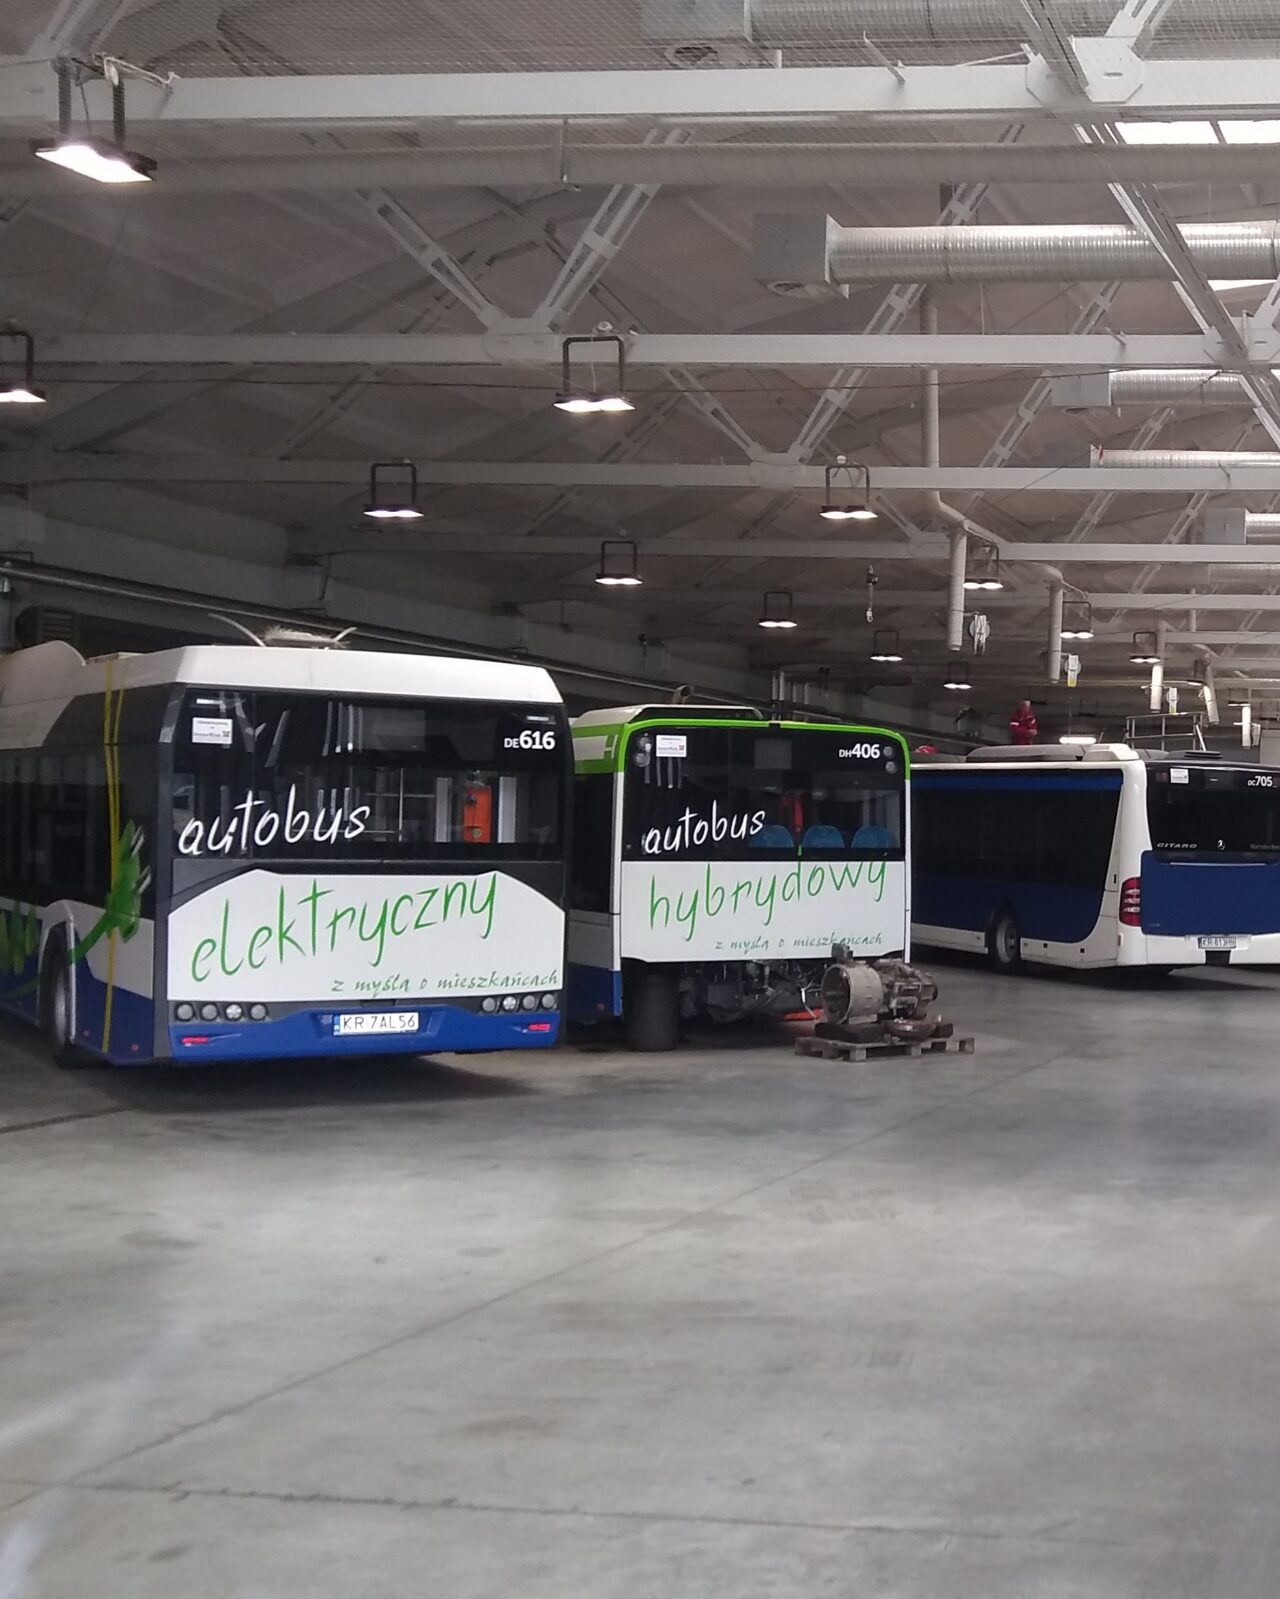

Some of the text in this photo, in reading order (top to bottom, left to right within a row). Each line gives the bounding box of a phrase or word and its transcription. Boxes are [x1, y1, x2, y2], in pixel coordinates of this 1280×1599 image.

[503, 730, 556, 750] DE616
[838, 743, 881, 759] DH406
[178, 783, 370, 856] autobus
[644, 799, 766, 854] autobus
[650, 845, 888, 942] hybrydowy
[191, 873, 497, 982] elektryczny
[714, 941, 723, 950] z
[778, 938, 785, 949] o
[331, 980, 345, 993] z
[419, 978, 428, 990] o
[437, 969, 558, 990] mieszkańcach
[342, 1014, 417, 1030] KR 7AL56
